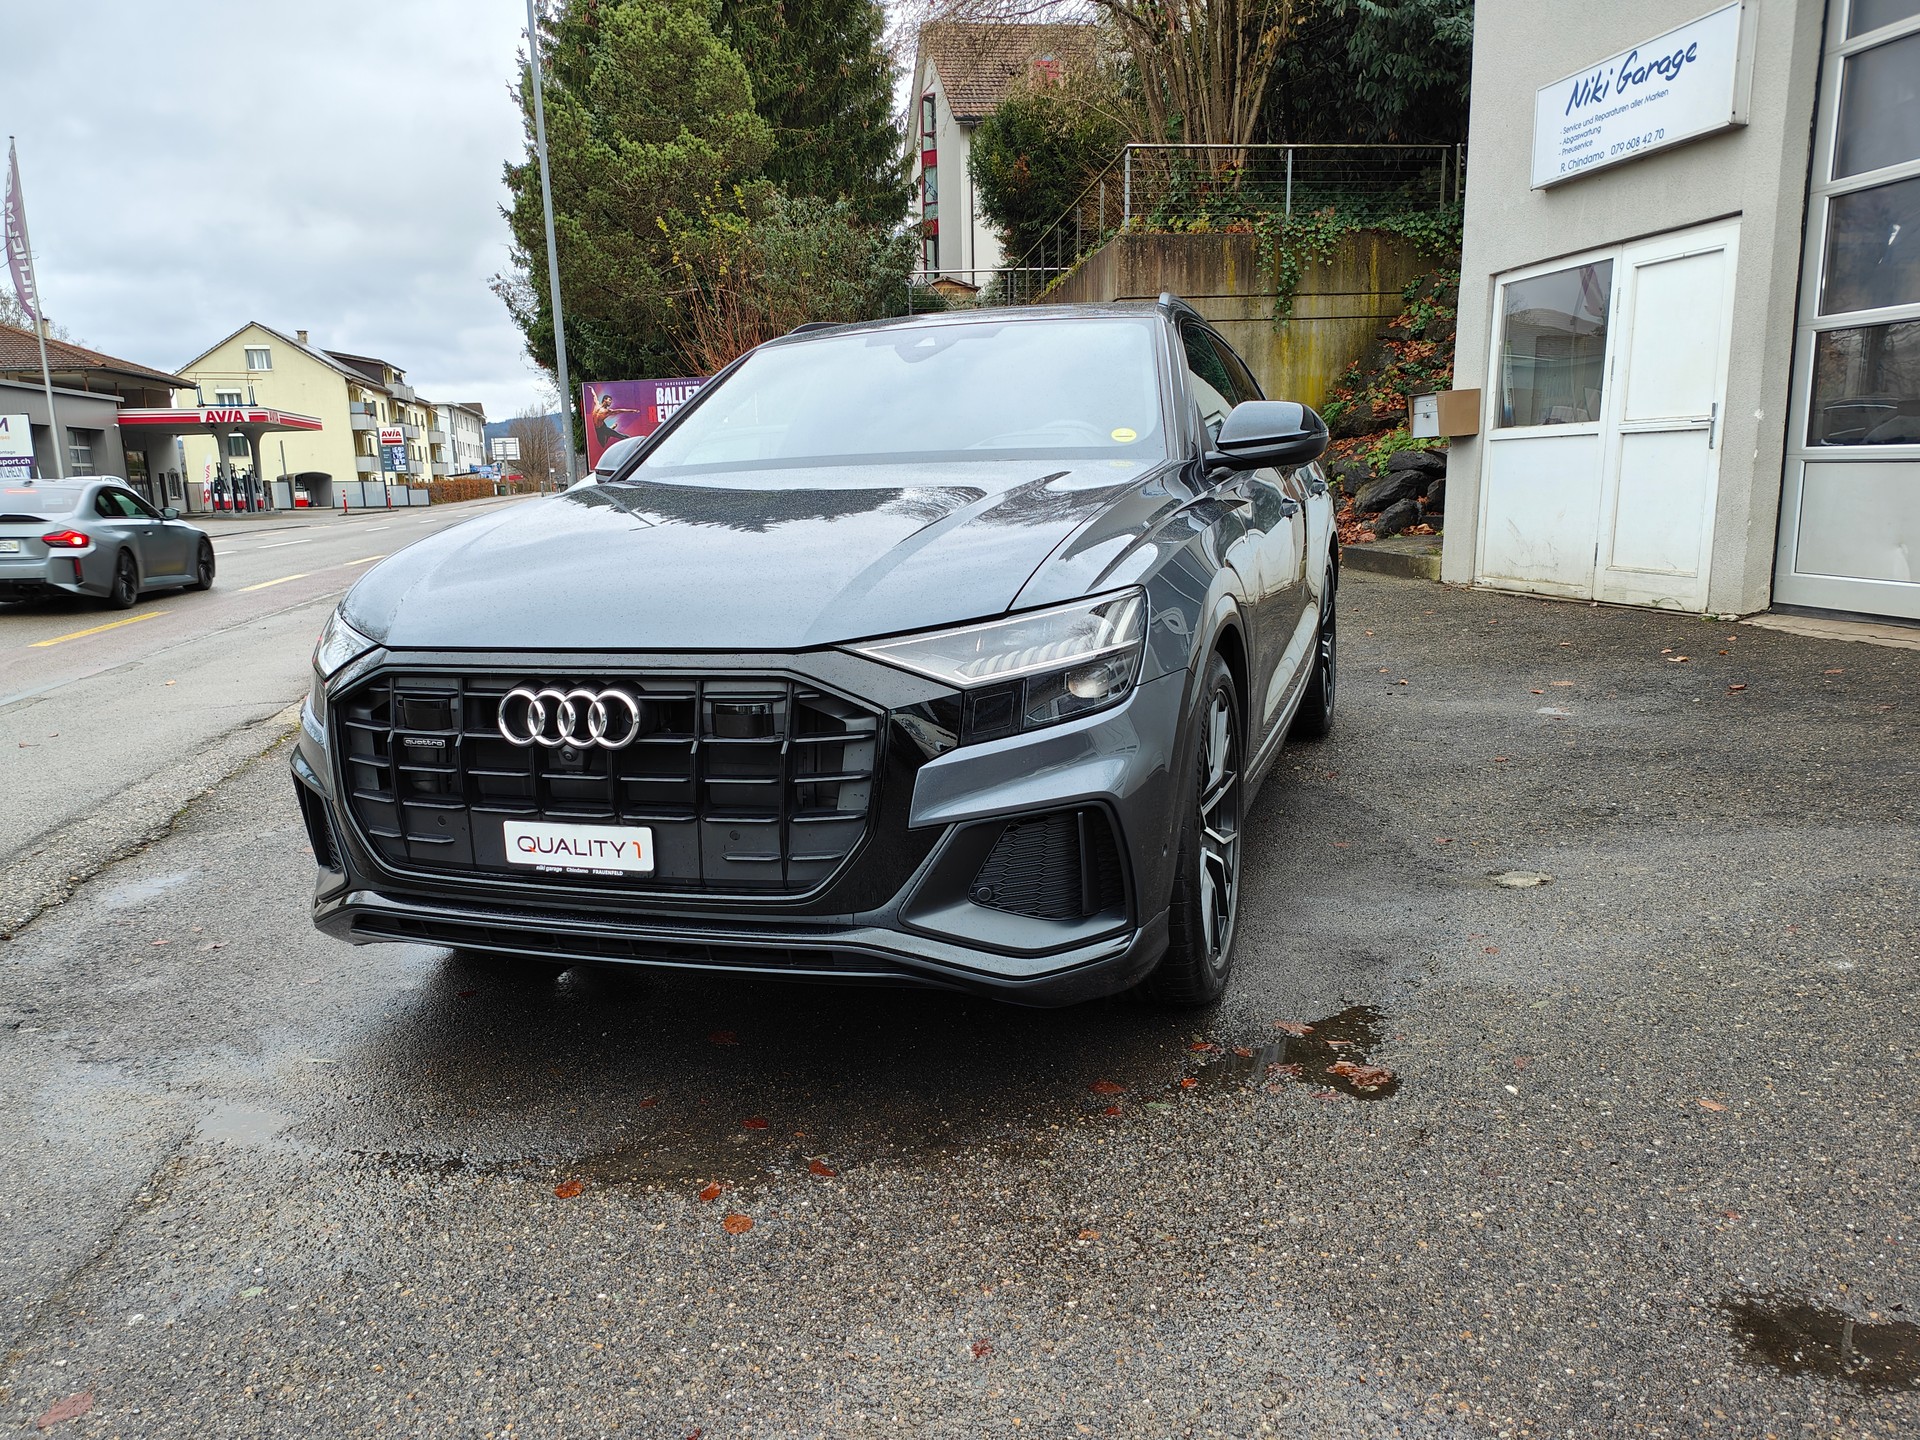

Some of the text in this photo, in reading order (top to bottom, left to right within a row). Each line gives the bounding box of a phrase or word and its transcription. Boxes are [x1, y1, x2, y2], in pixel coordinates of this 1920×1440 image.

[1565, 42, 1698, 116] Niki Garage
[1563, 88, 1669, 135] Service und Reparaturen aller Marken
[1562, 126, 1602, 145] Abgaswartung
[1561, 139, 1594, 156] Pneuservice
[1567, 150, 1605, 170] Chindamo
[1610, 141, 1625, 156] 079
[1625, 136, 1640, 150] 608
[1641, 132, 1652, 145] 42
[1654, 128, 1665, 141] 70
[206, 410, 246, 423] AVIA
[381, 429, 402, 438] AVIA
[517, 835, 642, 859] QUALITY 1
